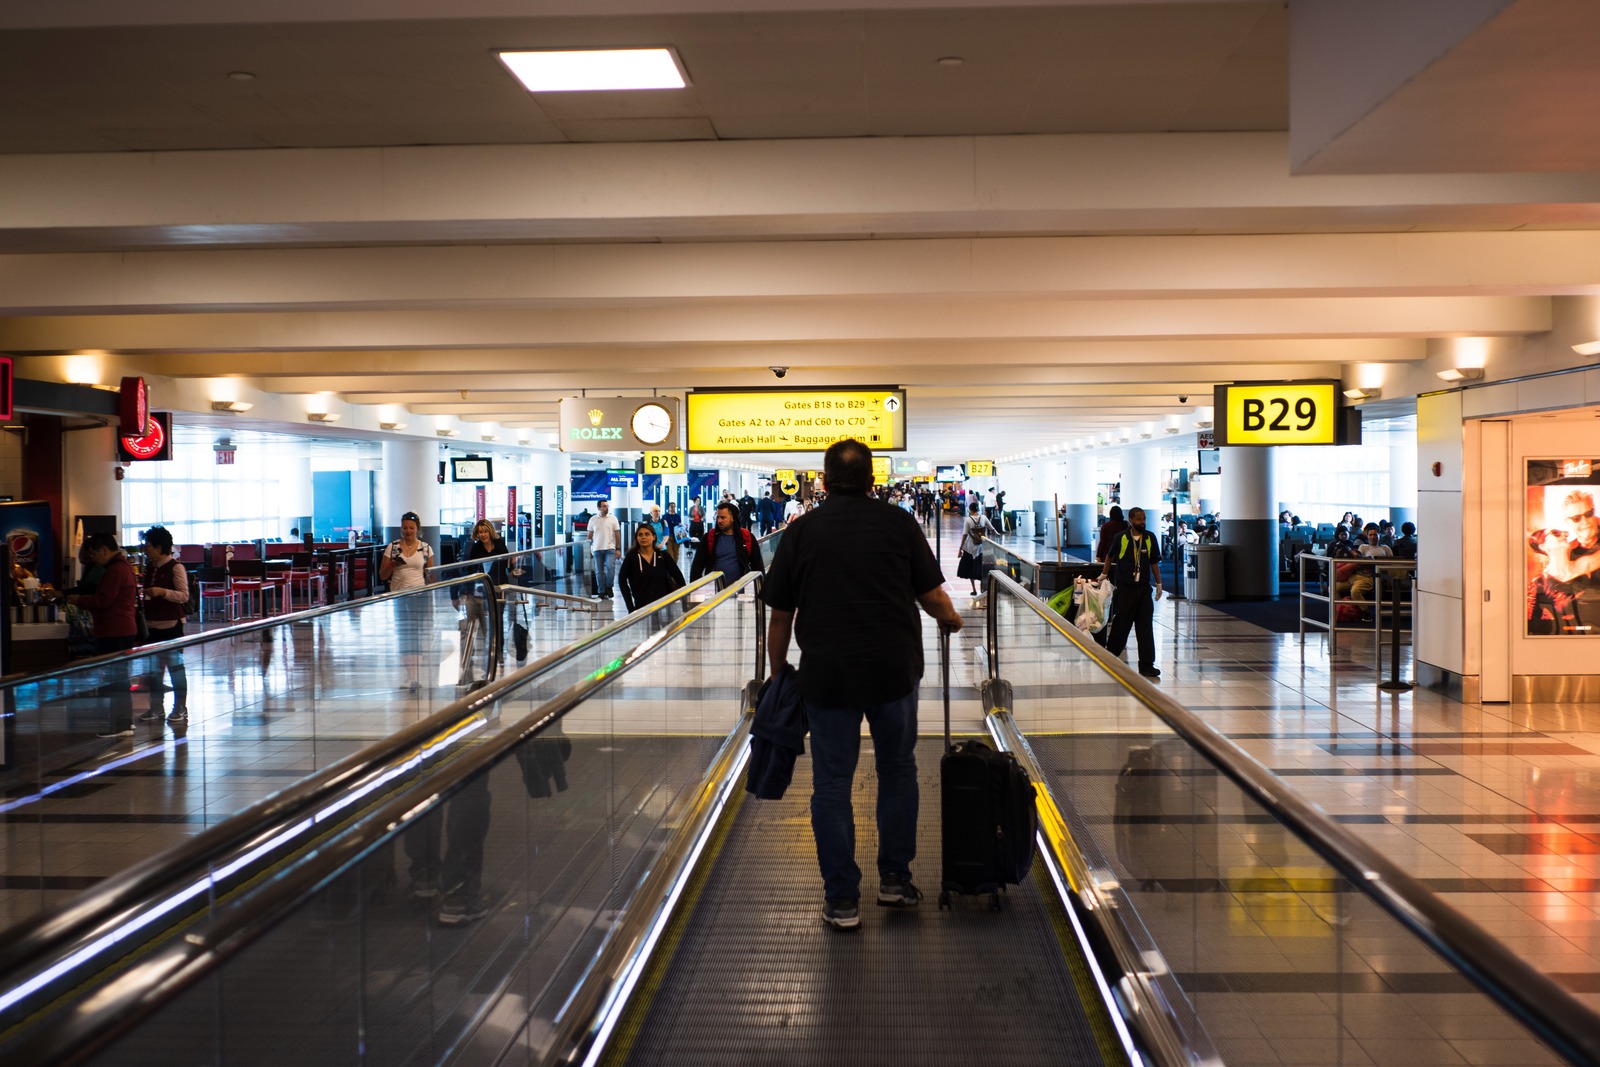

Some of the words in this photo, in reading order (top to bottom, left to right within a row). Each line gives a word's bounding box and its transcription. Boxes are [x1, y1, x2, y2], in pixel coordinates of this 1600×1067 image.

[784, 401, 812, 409] Gates
[814, 401, 832, 409] B18
[835, 401, 845, 409] to
[848, 401, 865, 409] B29
[1243, 397, 1316, 431] B29
[718, 418, 746, 427] Gates
[749, 418, 762, 427] A2
[765, 418, 775, 427] to
[778, 418, 791, 426] A7
[794, 417, 812, 426] and
[815, 417, 832, 426] C60
[835, 418, 845, 426] to
[847, 417, 865, 426] C70
[570, 427, 622, 440] ROLEX
[717, 435, 754, 444] Arrivals
[757, 434, 776, 443] Hall
[794, 435, 836, 445] Baggage
[218, 451, 234, 464] EXIT
[651, 456, 679, 469] B28
[971, 465, 988, 473] B27
[779, 471, 792, 479] B26
